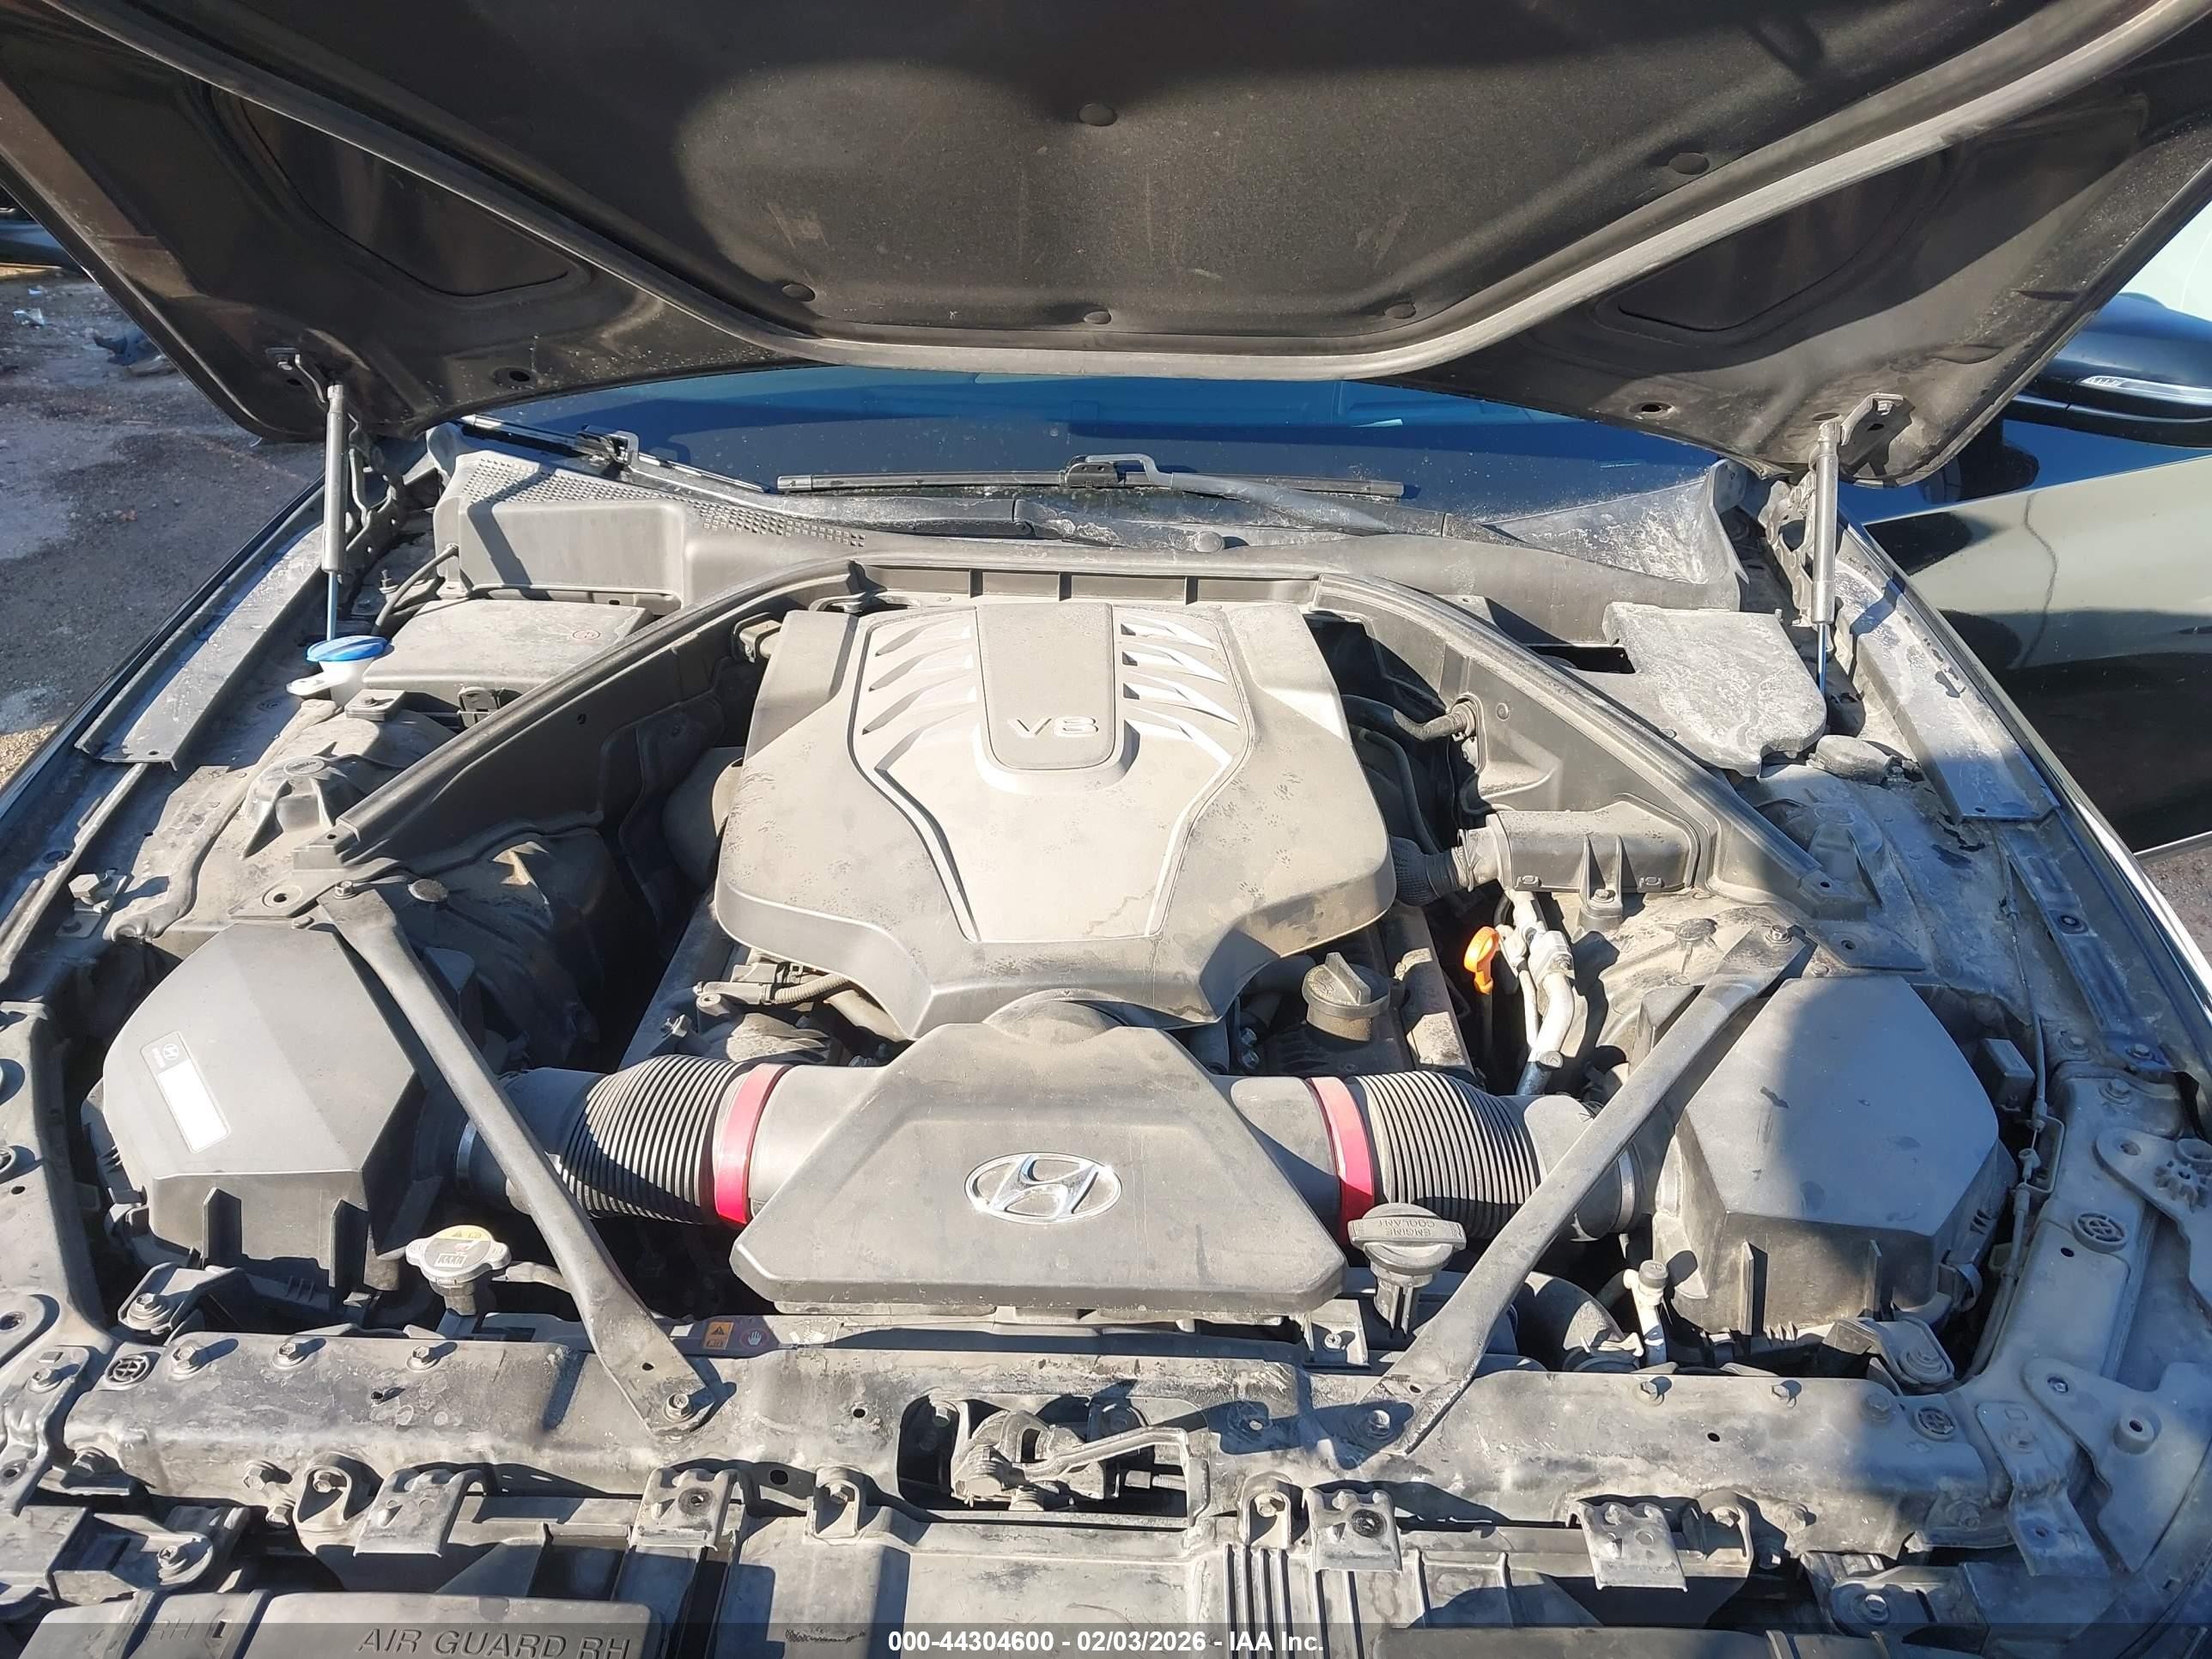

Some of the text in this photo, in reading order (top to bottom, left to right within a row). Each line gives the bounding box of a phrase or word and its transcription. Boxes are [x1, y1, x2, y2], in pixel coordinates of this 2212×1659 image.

[1006, 715, 1098, 738] V8
[1378, 1218, 1436, 1227] COOLANT
[145, 1618, 195, 1642] RH
[358, 1628, 631, 1659] AIR GUARD RH
